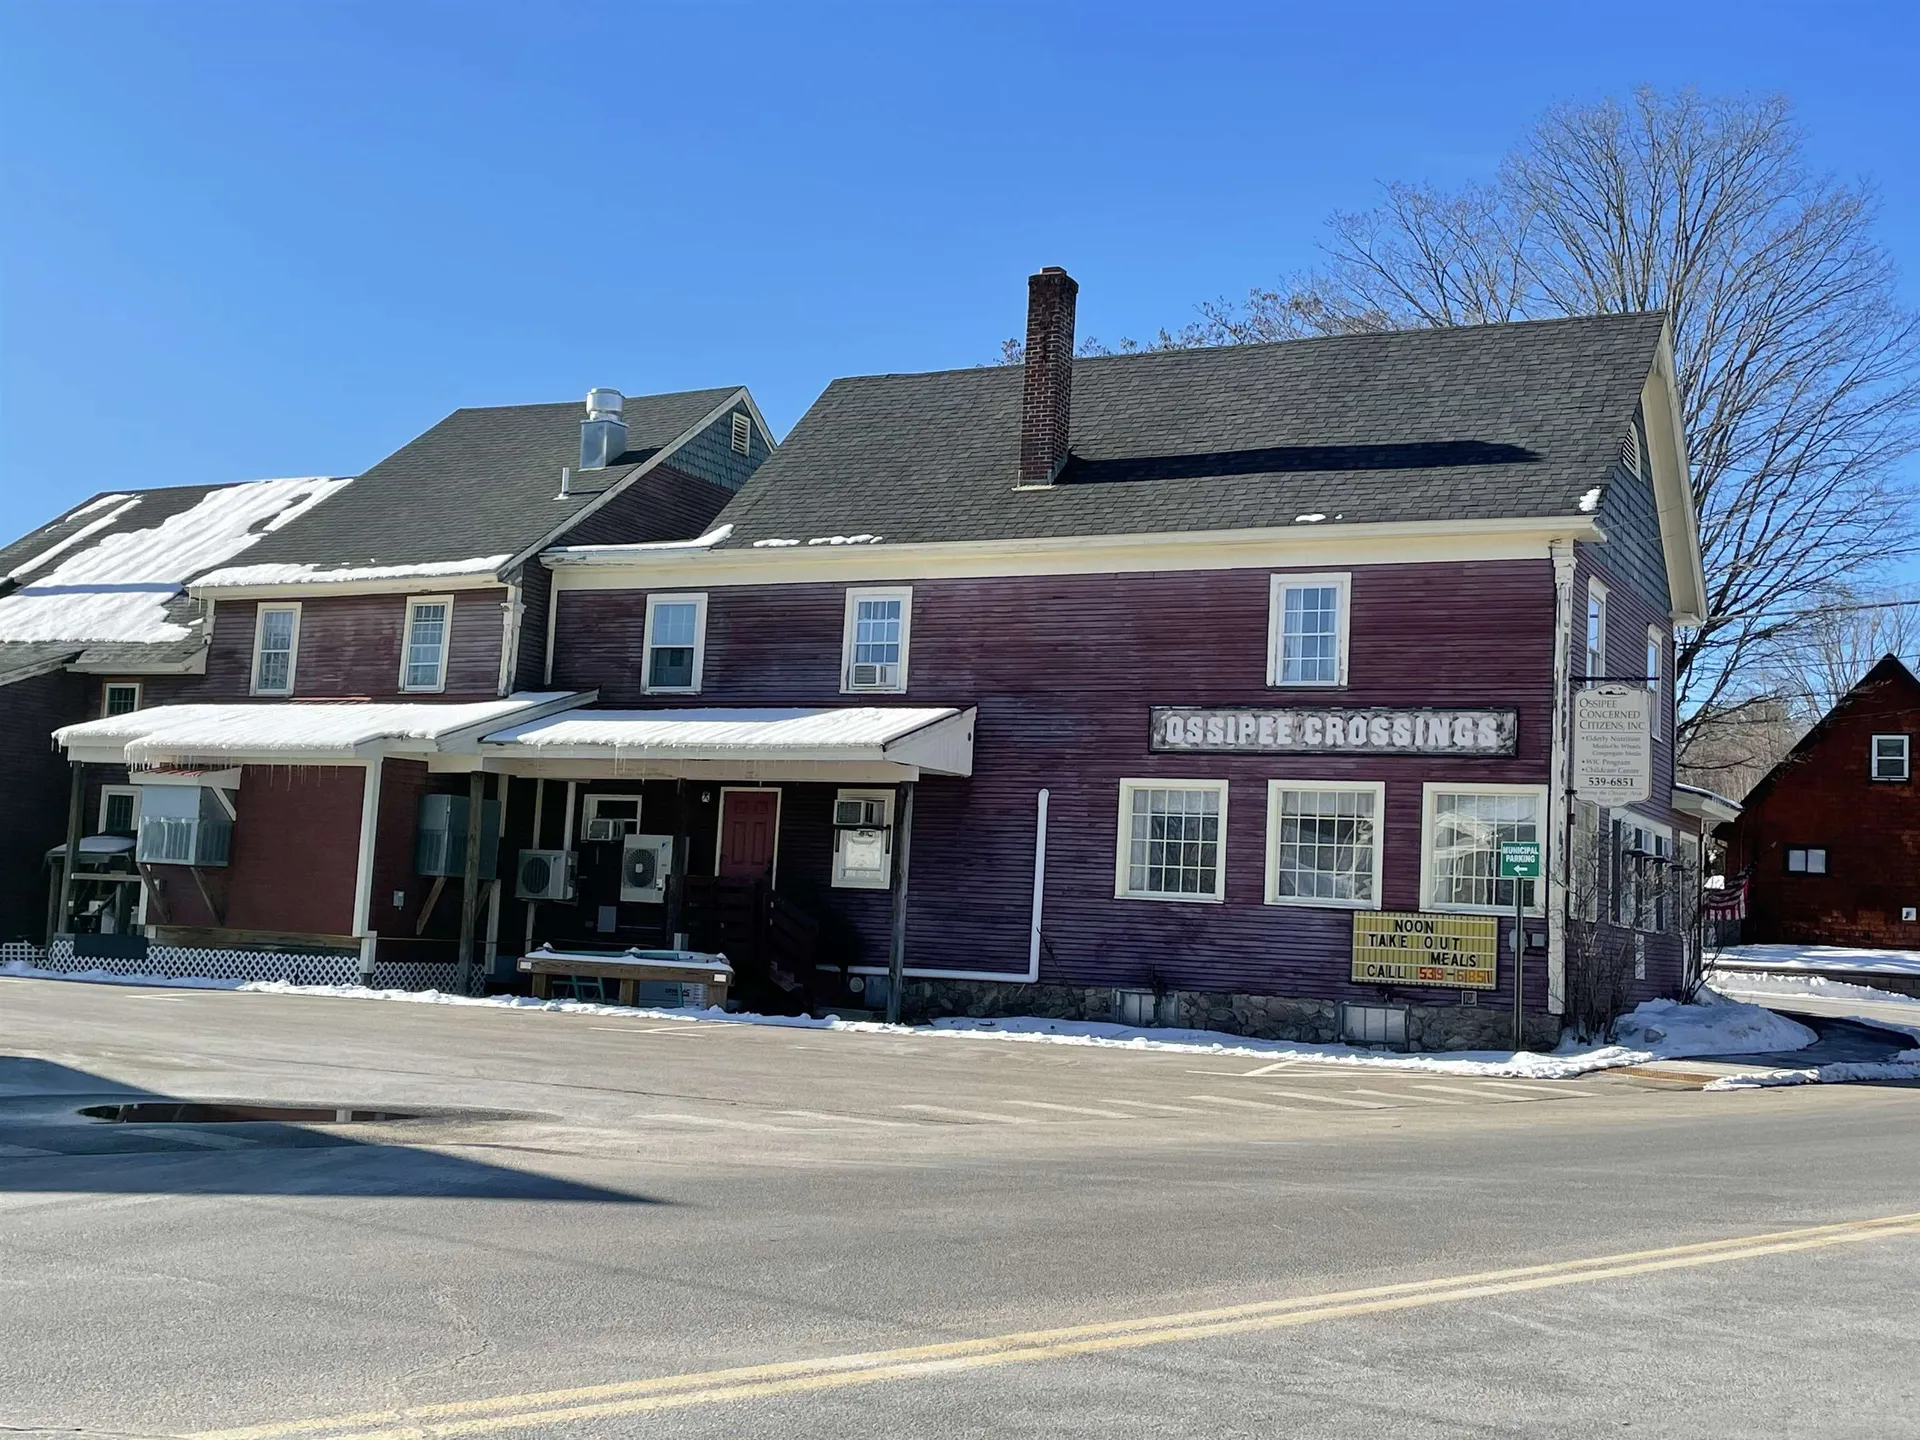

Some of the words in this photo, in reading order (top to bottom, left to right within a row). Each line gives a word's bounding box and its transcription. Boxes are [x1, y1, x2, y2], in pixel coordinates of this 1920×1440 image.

[1580, 698, 1617, 708] OSSIPEE
[1580, 709, 1640, 719] CONCERNED
[1165, 716, 1292, 745] OSSIPEE
[1304, 716, 1498, 747] CROSSINGS
[1588, 777, 1635, 787] 539-6851
[1503, 846, 1539, 854] MUNICIPAL
[1506, 855, 1535, 863] PARKING
[1395, 919, 1434, 934] NOON
[1369, 933, 1408, 948] TAKE
[1424, 936, 1460, 951] OUT
[1430, 951, 1477, 968] MEALS
[1367, 964, 1405, 979] CALL
